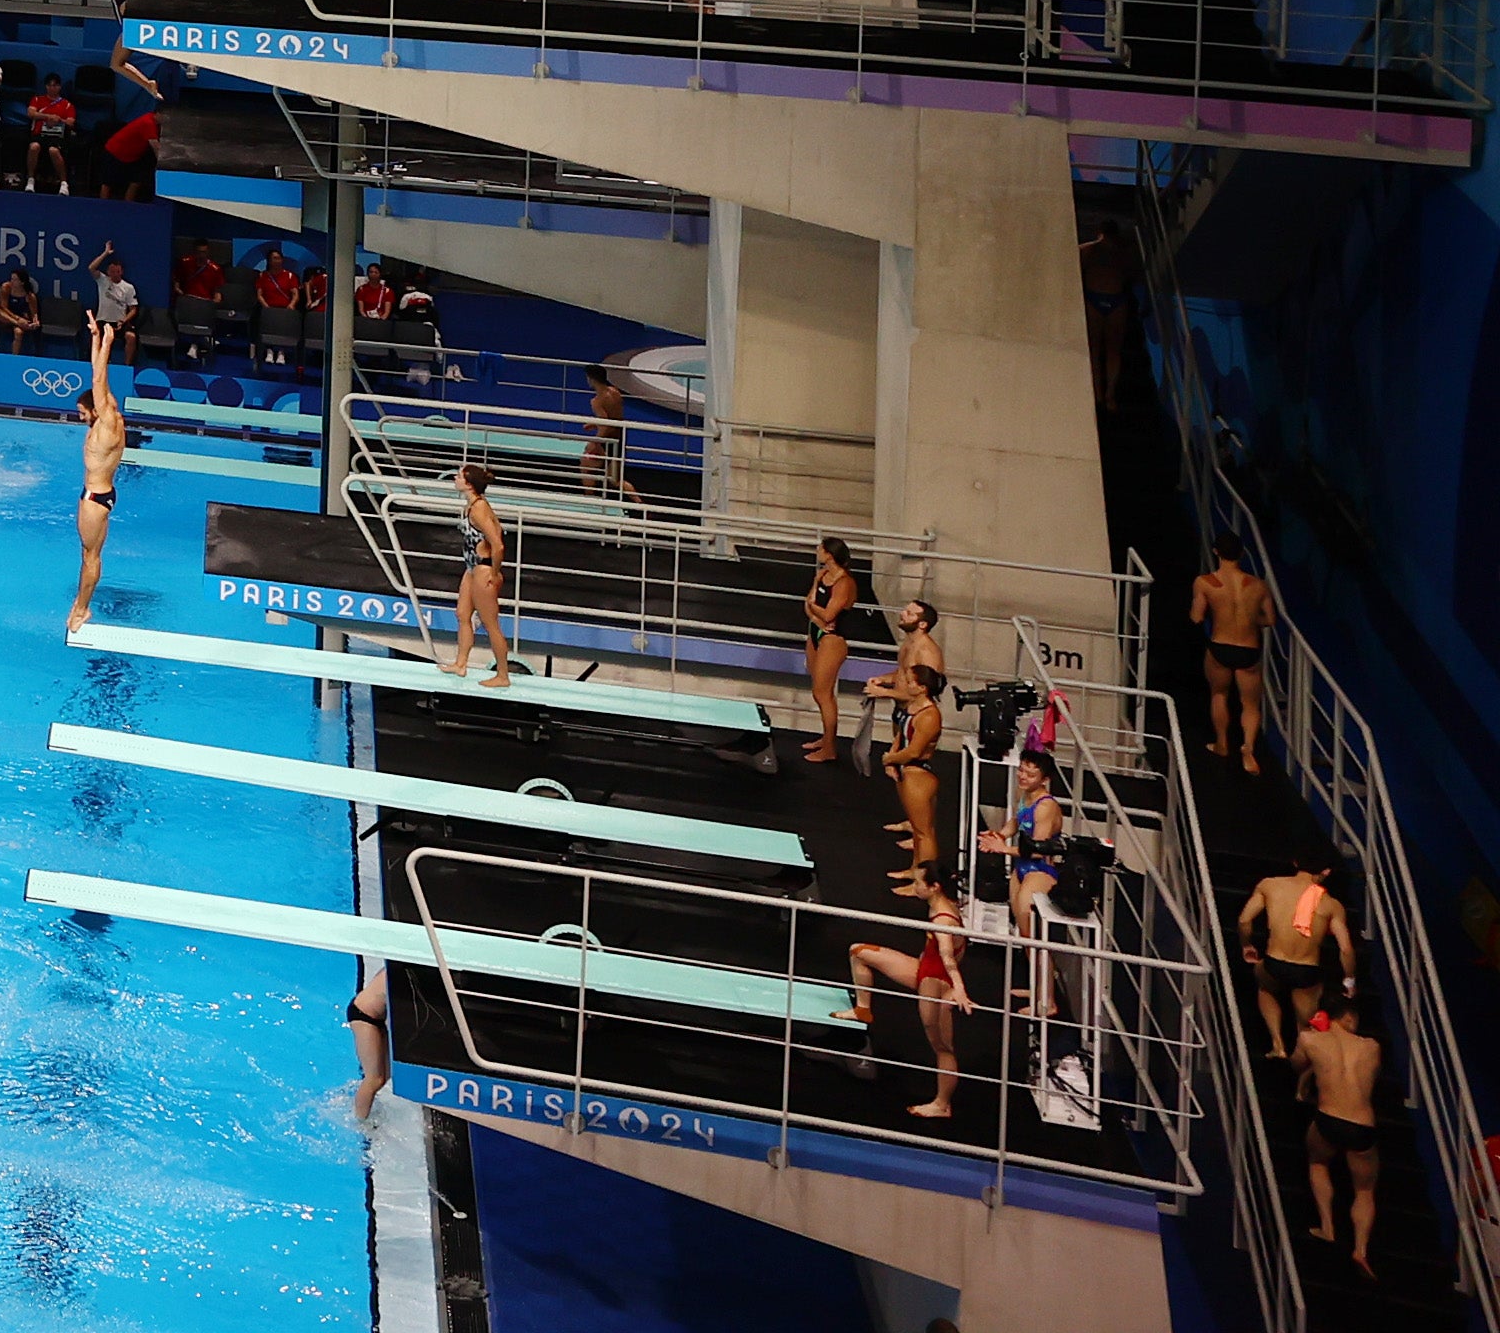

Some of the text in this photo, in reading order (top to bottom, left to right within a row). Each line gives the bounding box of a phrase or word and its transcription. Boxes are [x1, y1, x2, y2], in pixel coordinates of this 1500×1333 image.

[256, 32, 348, 60] 2024
[1039, 641, 1083, 670] 3m
[586, 1101, 714, 1148] 2024
